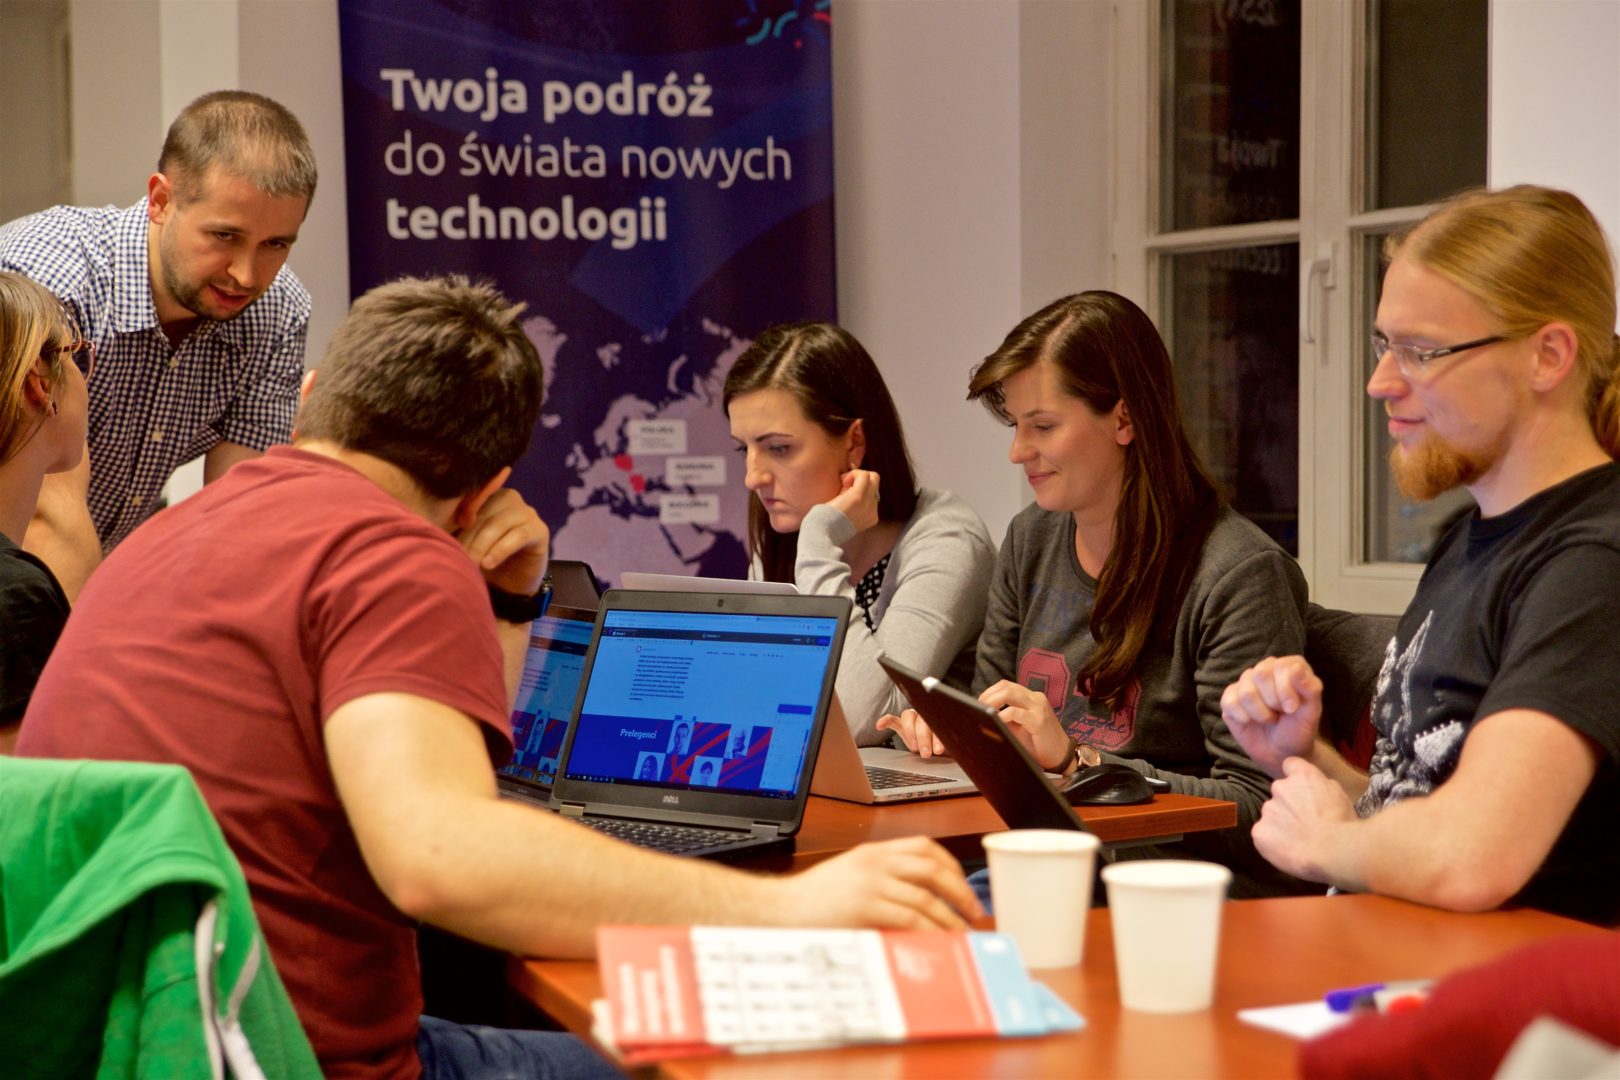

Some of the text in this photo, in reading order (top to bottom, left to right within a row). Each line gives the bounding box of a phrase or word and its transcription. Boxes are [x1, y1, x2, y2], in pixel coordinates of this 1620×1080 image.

[379, 68, 715, 123] Twoja podróż
[384, 130, 792, 189] do świata nowych
[386, 195, 668, 251] technologii
[619, 728, 658, 740] Prelegenci
